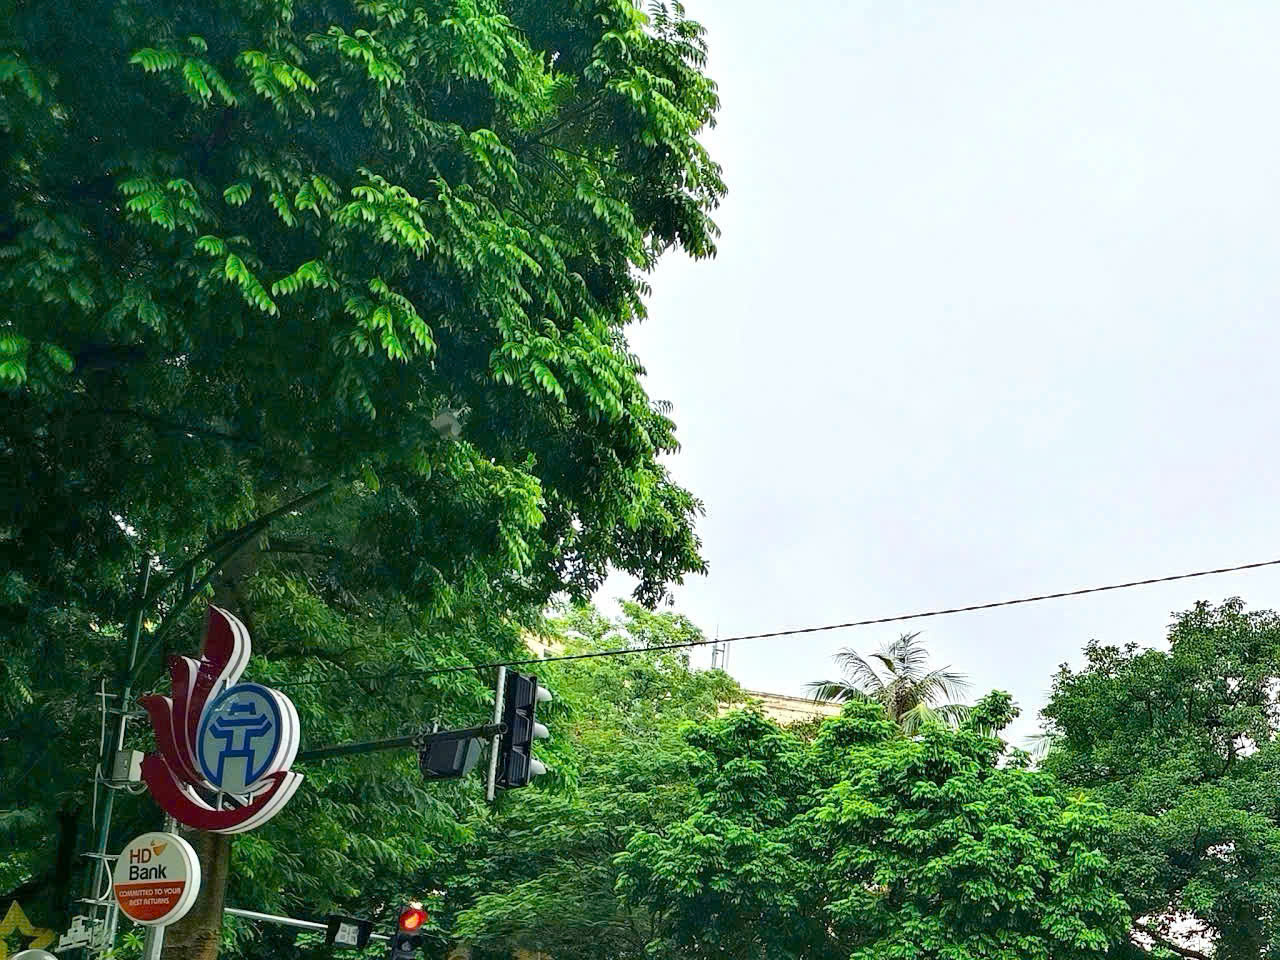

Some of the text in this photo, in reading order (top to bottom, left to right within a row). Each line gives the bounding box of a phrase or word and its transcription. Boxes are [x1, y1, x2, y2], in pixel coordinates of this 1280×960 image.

[129, 848, 152, 864] HD
[129, 864, 167, 881] Bank
[154, 888, 163, 896] TO
